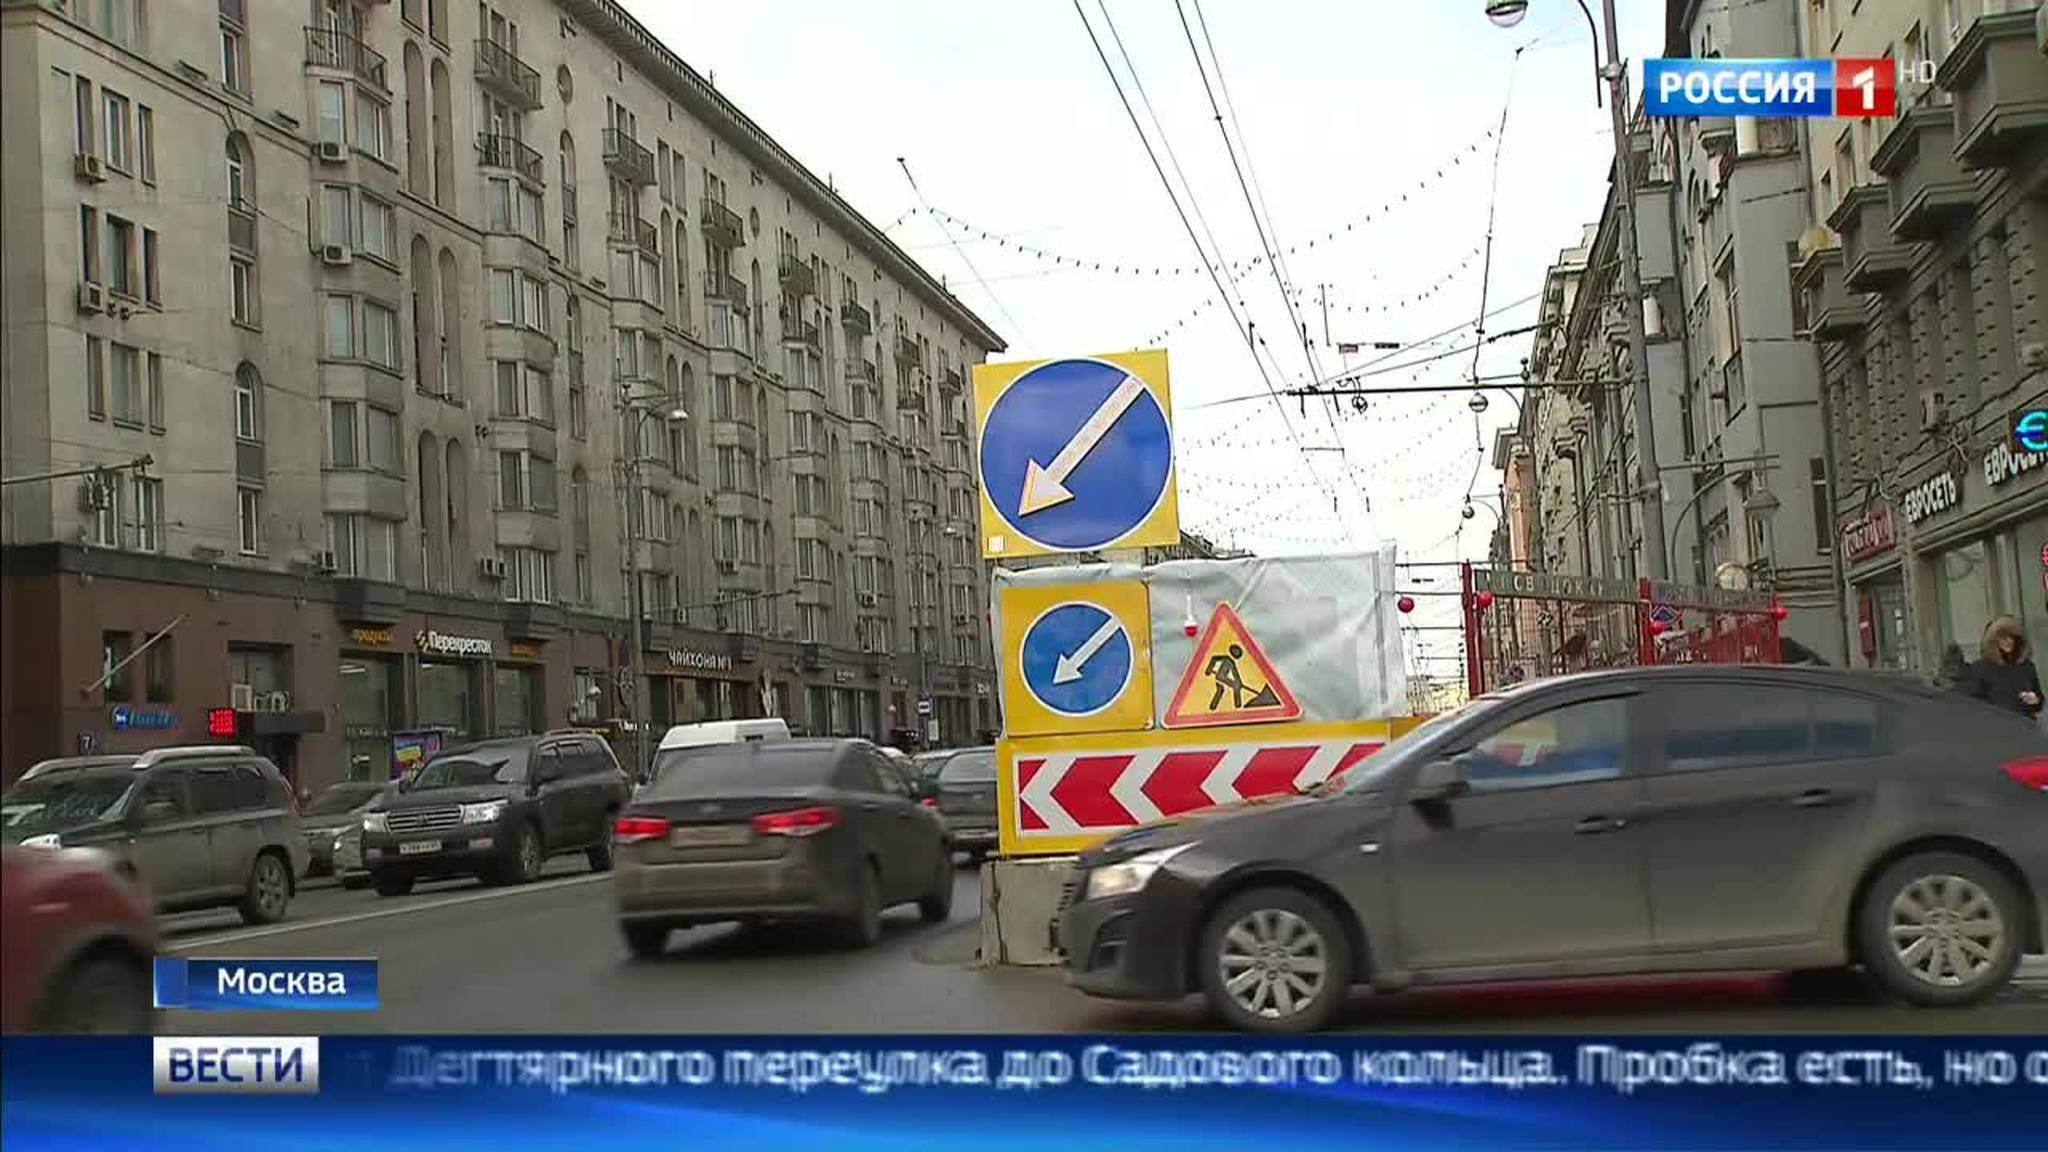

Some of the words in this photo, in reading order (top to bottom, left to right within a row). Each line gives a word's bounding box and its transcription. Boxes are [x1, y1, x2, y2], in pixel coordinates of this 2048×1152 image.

[1905, 470, 1956, 523] ЕВРОСЕТЬ
[428, 631, 493, 656] Перекресток
[668, 648, 716, 669] ЧАЙХОНА
